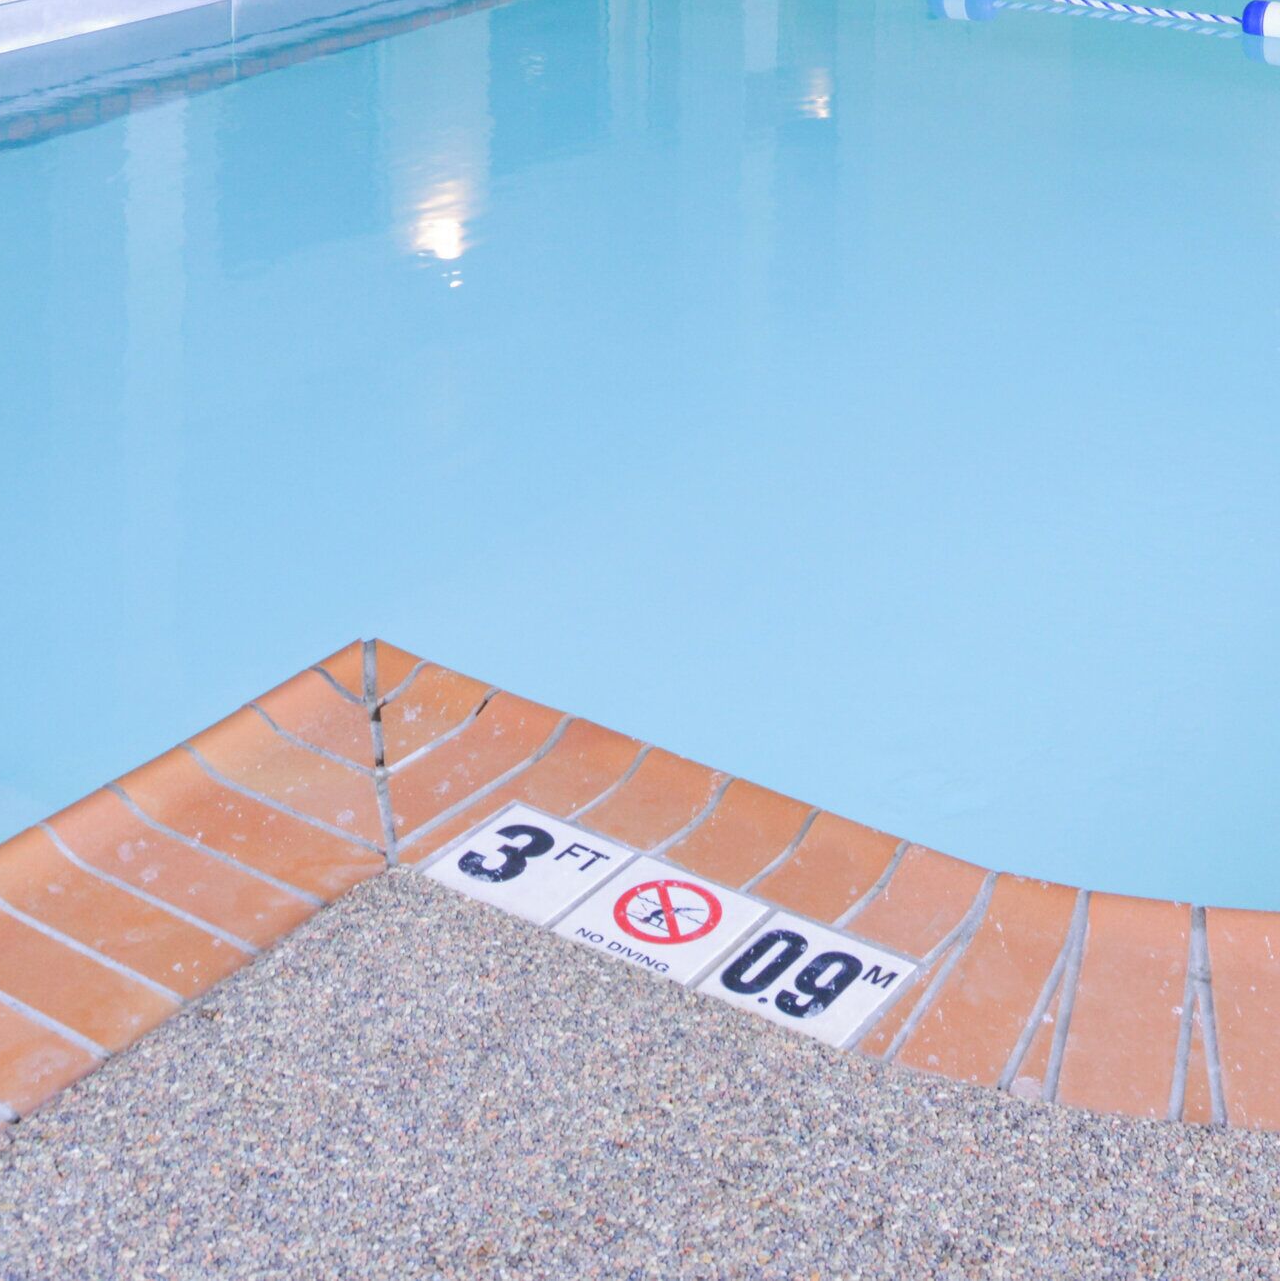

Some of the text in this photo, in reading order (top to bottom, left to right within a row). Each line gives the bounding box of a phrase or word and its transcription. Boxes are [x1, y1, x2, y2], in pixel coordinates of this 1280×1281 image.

[457, 824, 610, 883] 3 FT
[575, 927, 670, 974] NO DIVING
[862, 965, 900, 989] M
